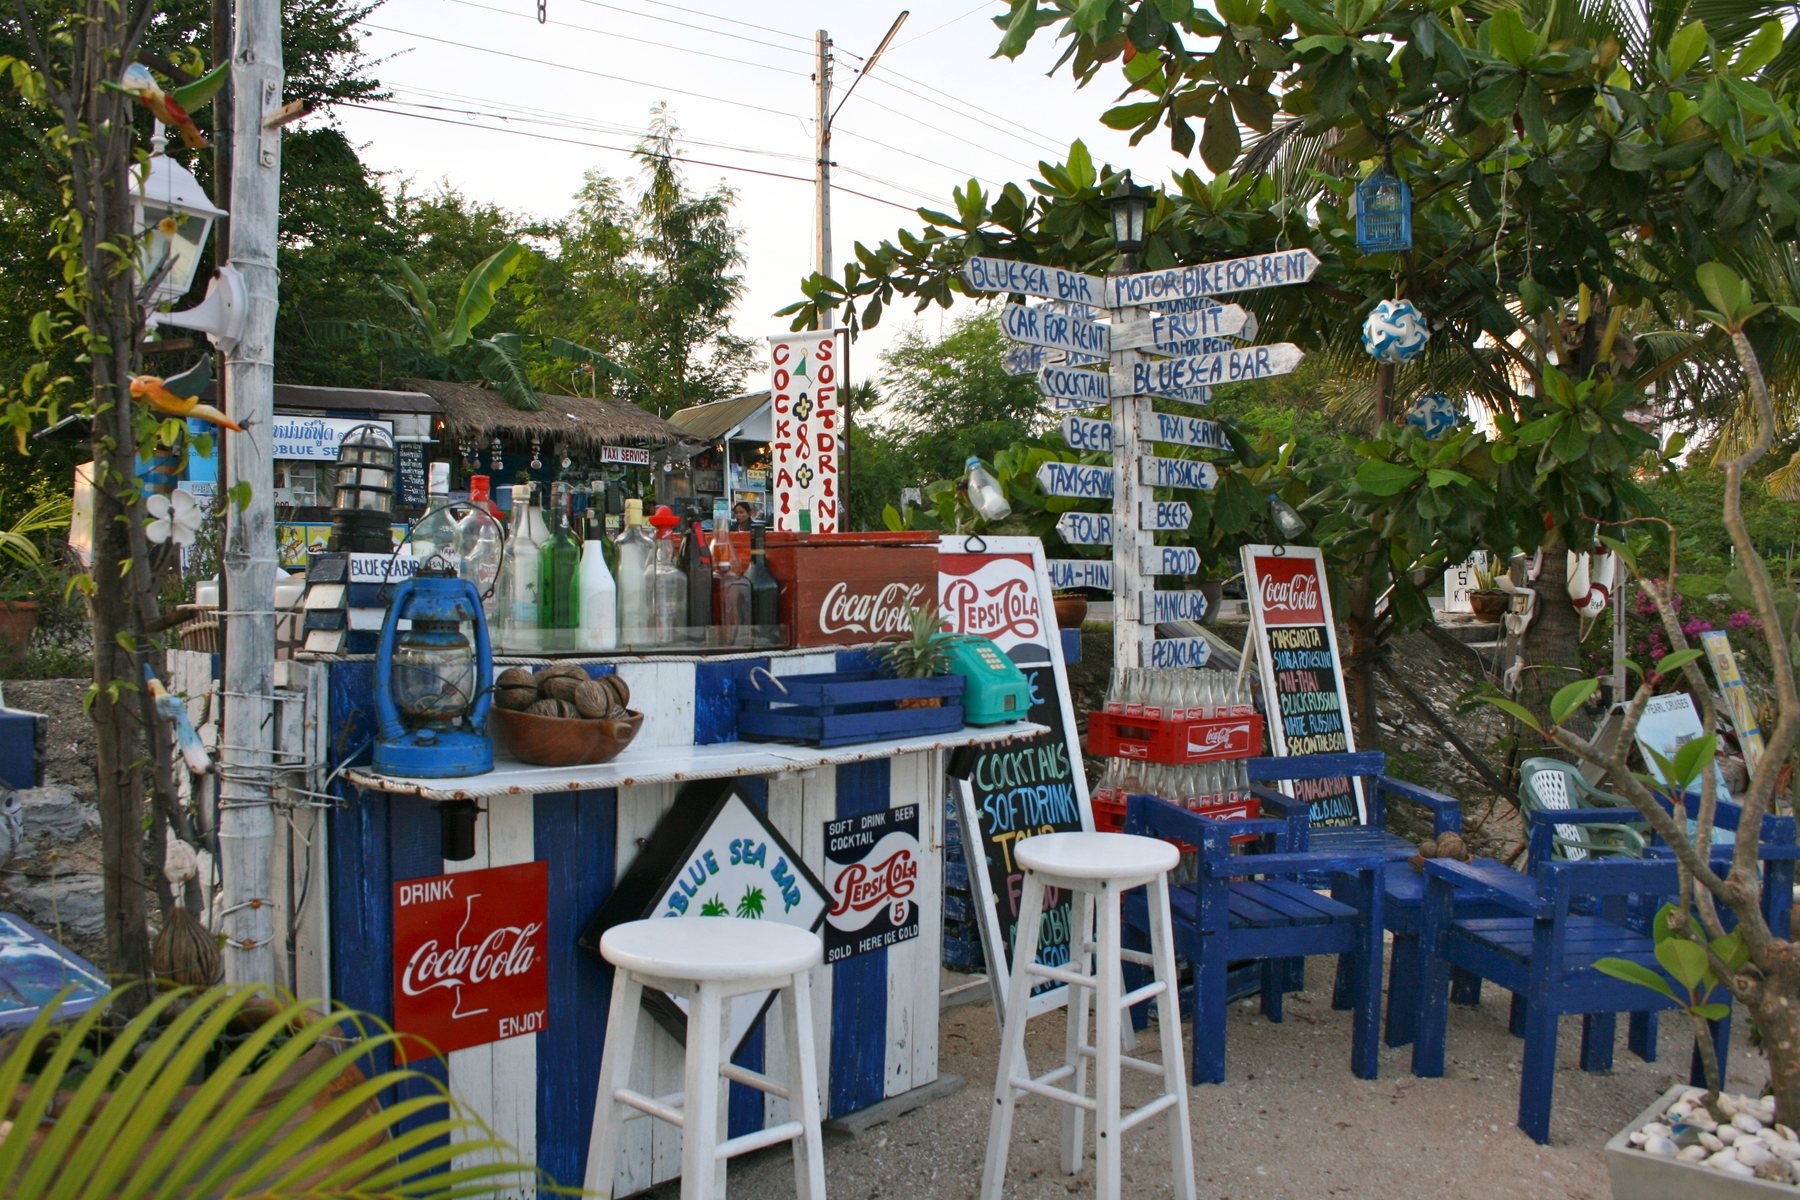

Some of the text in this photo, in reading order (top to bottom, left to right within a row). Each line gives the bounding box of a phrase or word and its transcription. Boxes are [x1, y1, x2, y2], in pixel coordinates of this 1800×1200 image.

[1057, 271, 1092, 302] BAR
[1115, 251, 1308, 302] MOTOR BIKE FOR RENT
[1008, 306, 1106, 352] CAR FOR RENT
[1152, 307, 1223, 344] FRUIT
[1229, 348, 1273, 380] BAR
[1045, 369, 1108, 399] COCKTAIL
[773, 343, 794, 532] COCKTAIL
[1070, 418, 1112, 450] BEER
[1157, 414, 1184, 442] TAXI
[278, 444, 315, 456] BLUE
[603, 447, 649, 463] TAXI SERVICE
[1158, 459, 1208, 489] MASSAGE
[1068, 514, 1112, 543] TOUR
[1157, 502, 1189, 528] BEER
[1162, 548, 1197, 575] FOOD
[1153, 591, 1206, 623] MANICURE
[1260, 573, 1318, 612] Coca-Cola
[1151, 636, 1206, 668] PEDICURE
[1271, 627, 1322, 649] MARGARITA
[1284, 712, 1341, 737] WHITE RUSSIAN
[975, 742, 1070, 792] COCKTAILS
[828, 805, 915, 836] SOFT DRINK BEER
[830, 830, 875, 852] COCKTAIL
[668, 838, 802, 915] BLUE SEA BAR
[399, 878, 455, 907] DRINK
[893, 901, 905, 923] 5
[401, 921, 544, 996] Coca-Cola
[828, 944, 853, 962] SOLD
[859, 934, 883, 953] HERE
[498, 1009, 545, 1038] ENJOY
